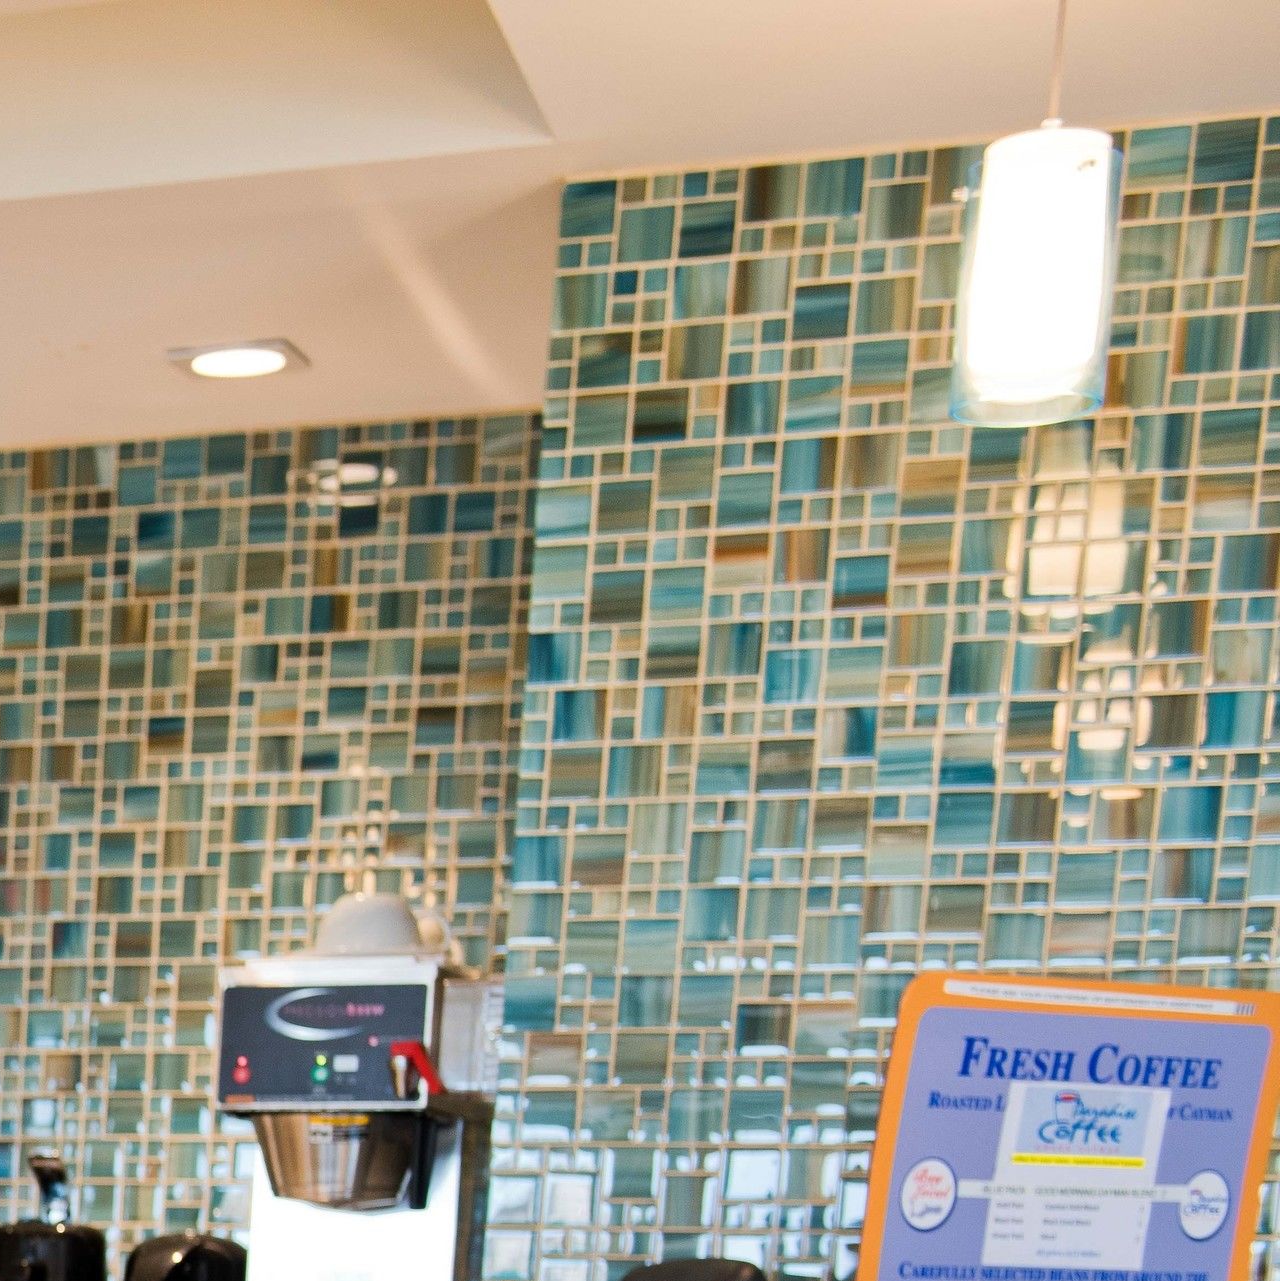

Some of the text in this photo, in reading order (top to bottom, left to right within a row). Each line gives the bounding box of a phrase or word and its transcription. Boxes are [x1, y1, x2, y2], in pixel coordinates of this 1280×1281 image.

[957, 1036, 1222, 1090] FRESH COFFEE
[1037, 1119, 1121, 1144] Coffee
[898, 1261, 976, 1281] CAREFULLY
[980, 1264, 1045, 1281] SELECTED
